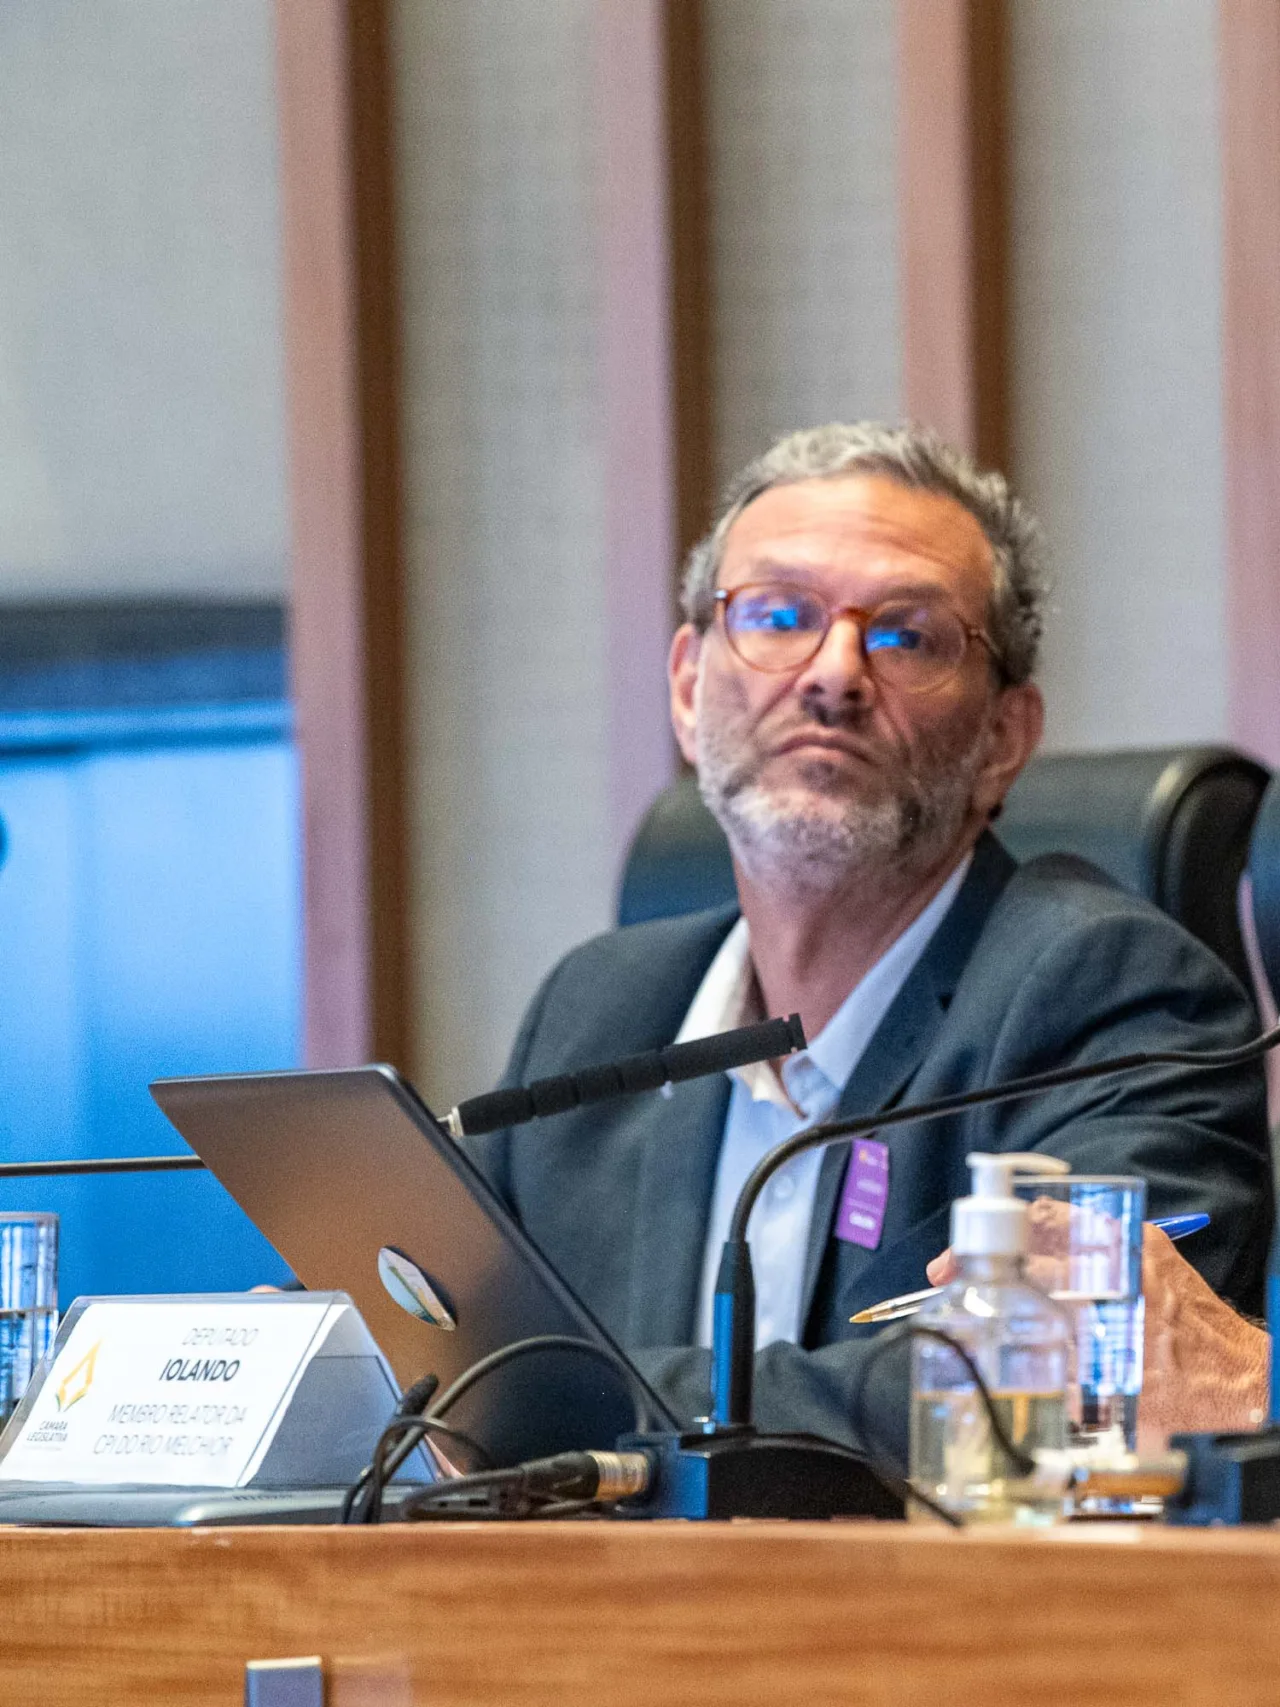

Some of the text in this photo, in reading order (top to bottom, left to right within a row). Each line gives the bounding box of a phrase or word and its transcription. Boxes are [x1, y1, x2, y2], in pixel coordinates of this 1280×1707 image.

[158, 1358, 241, 1382] IOLANDO
[107, 1404, 248, 1425] MEMBRO RELATOR DA
[115, 1434, 139, 1455] DO
